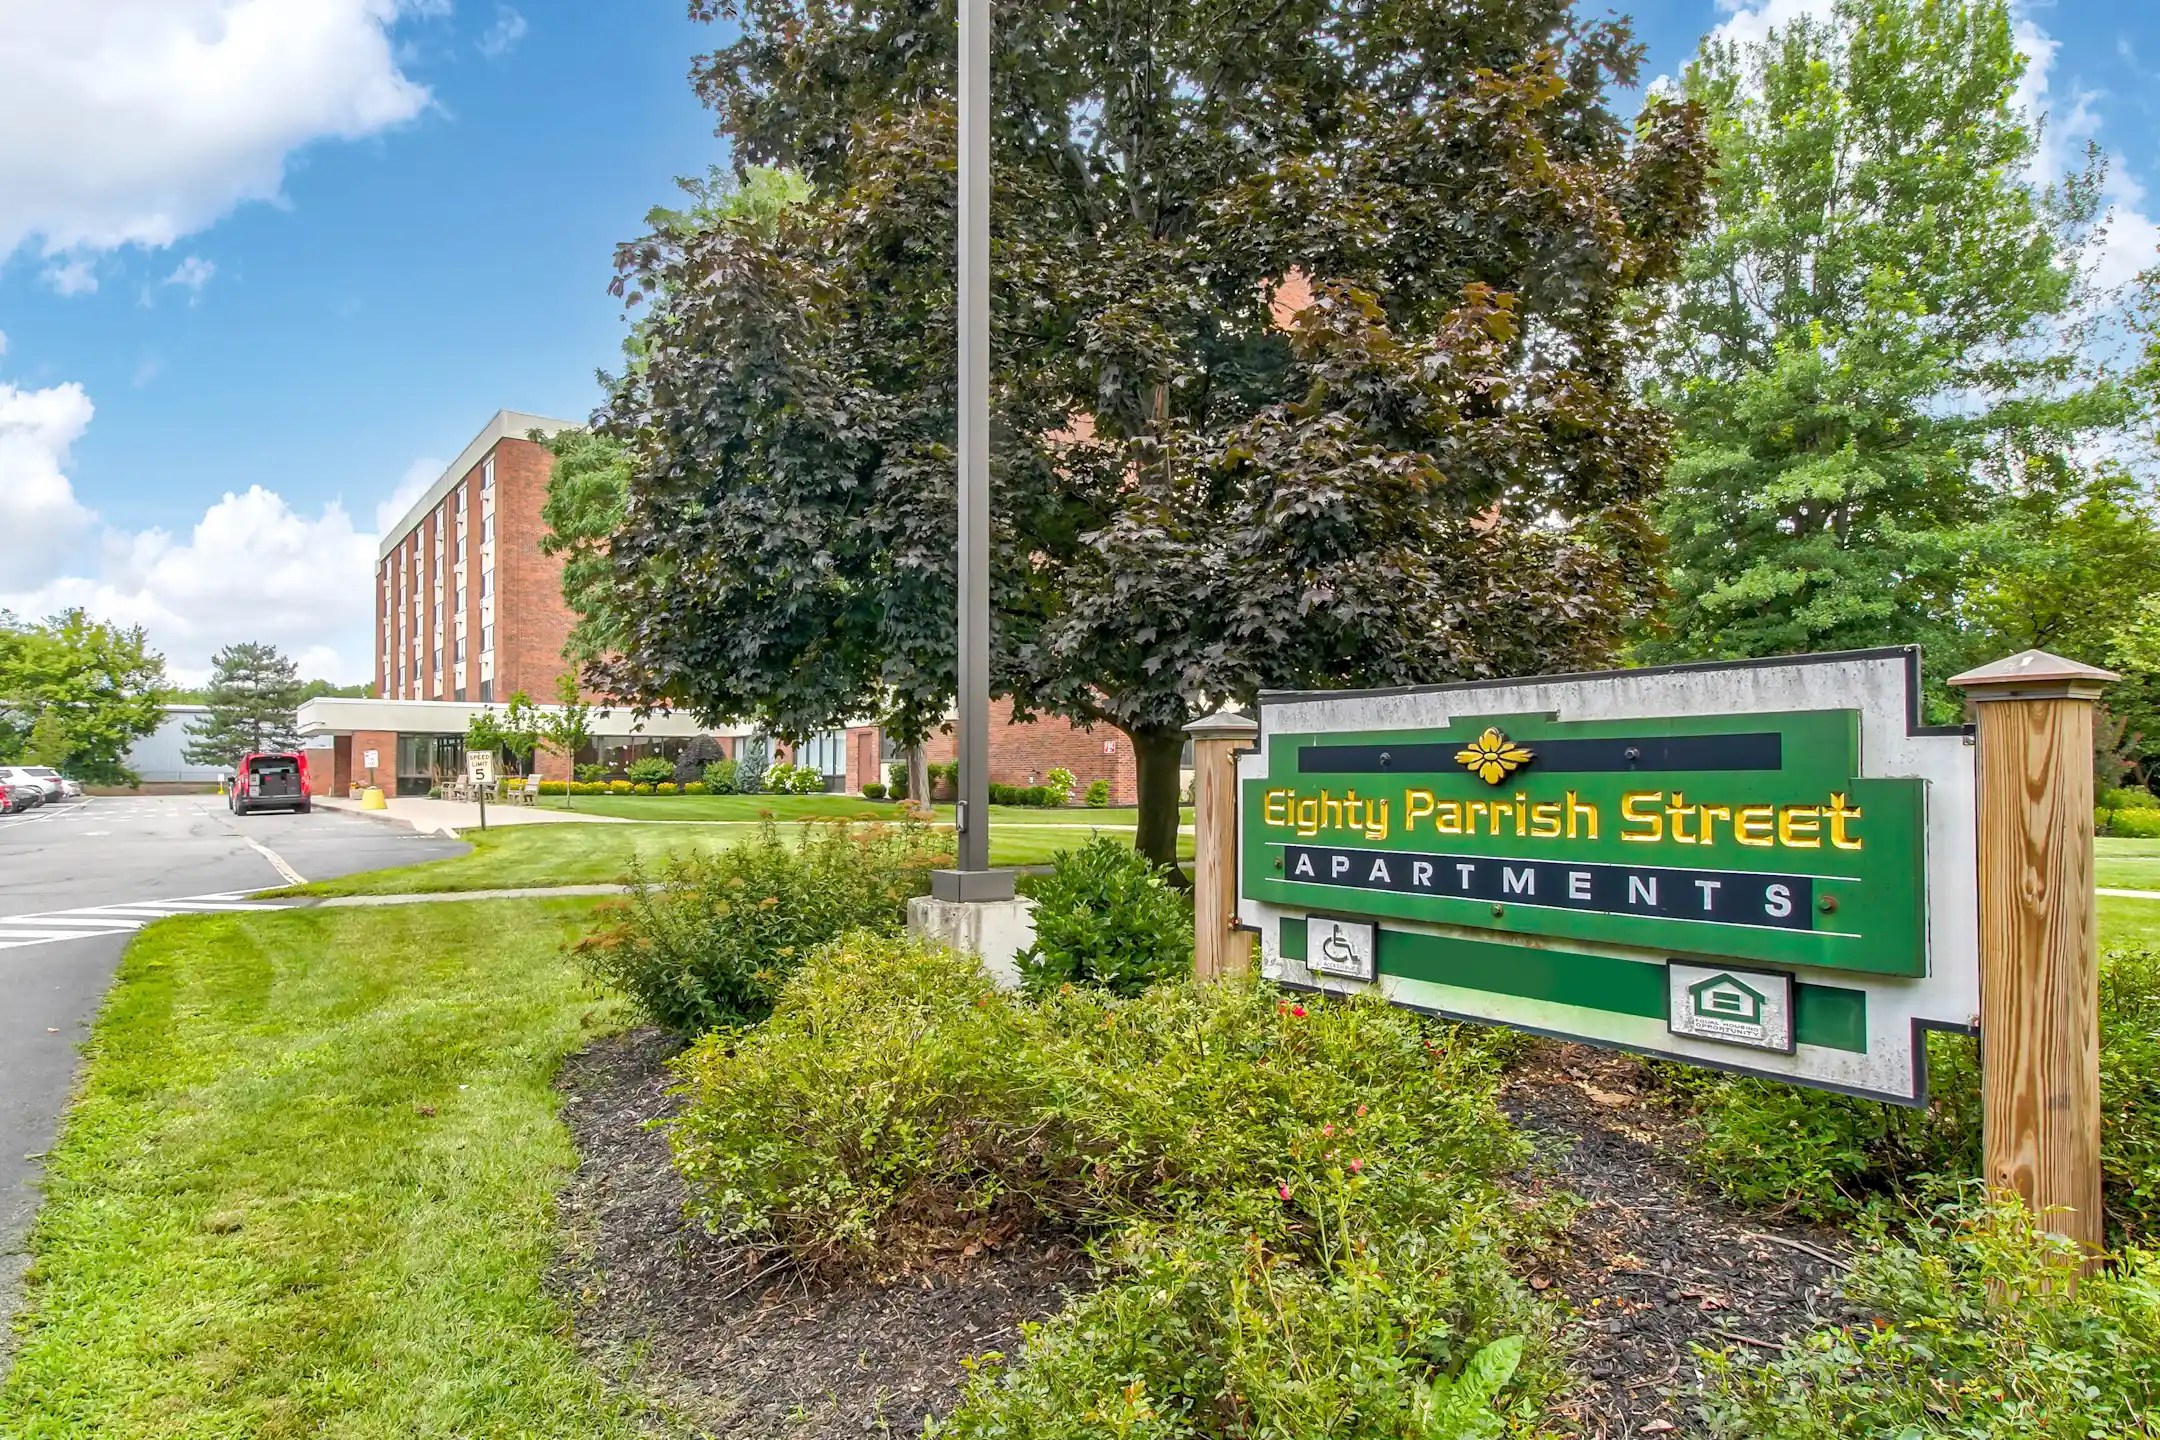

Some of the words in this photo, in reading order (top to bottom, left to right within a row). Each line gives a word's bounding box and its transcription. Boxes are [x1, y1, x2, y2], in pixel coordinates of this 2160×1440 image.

[475, 768, 485, 780] 5
[1264, 787, 1389, 840] Eighty
[1405, 788, 1599, 840] Parrish
[1621, 790, 1862, 851] Street
[1294, 853, 1793, 918] APARTMENTS
[1695, 1023, 1759, 1036] OPPORTUNITY
[1723, 1023, 1759, 1032] HOUSING
